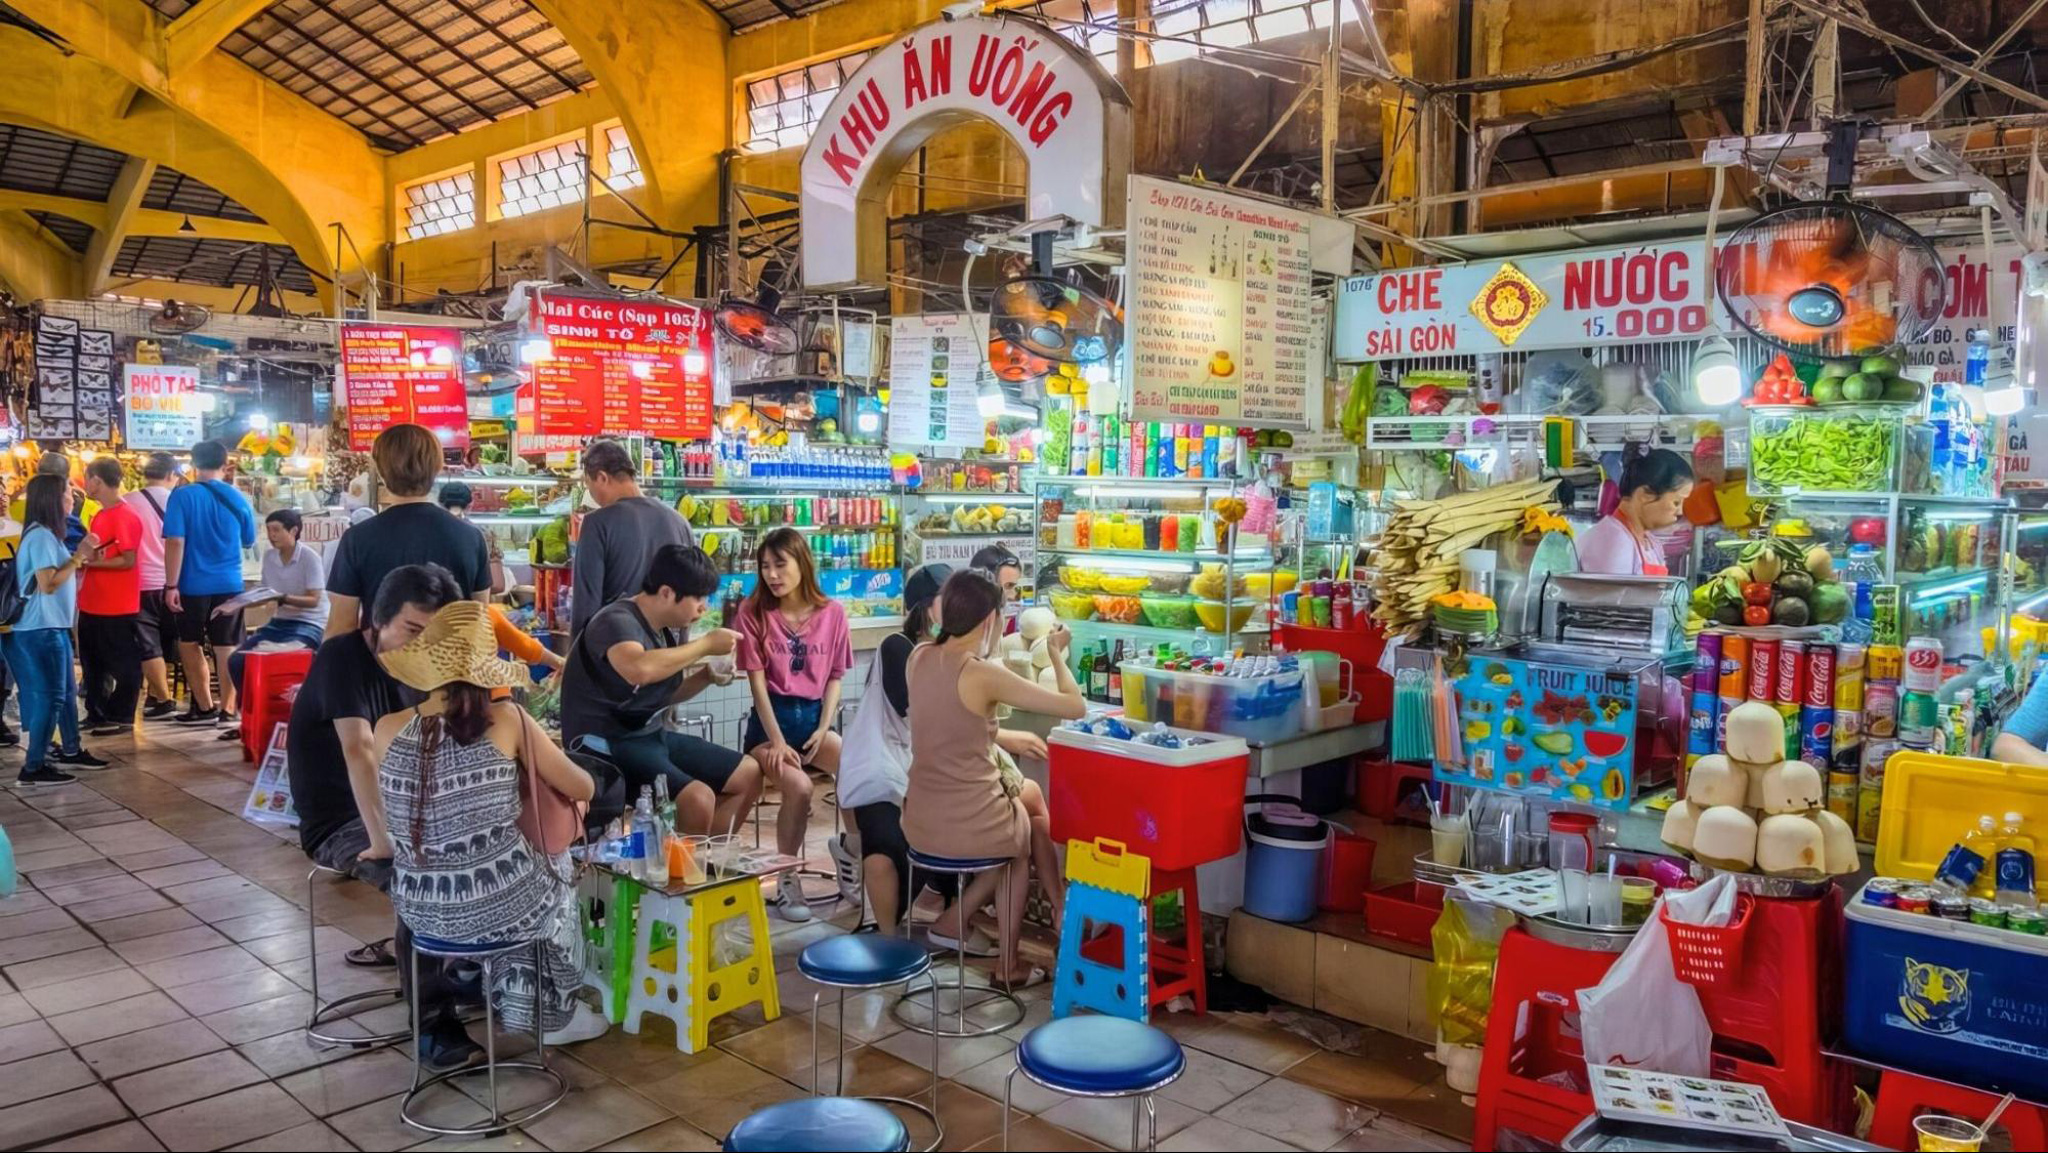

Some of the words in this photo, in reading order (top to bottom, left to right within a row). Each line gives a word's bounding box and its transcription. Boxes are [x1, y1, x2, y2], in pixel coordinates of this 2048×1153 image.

[822, 77, 890, 186] KHU
[902, 36, 952, 109] ĂN
[968, 34, 1073, 148] UỐNG
[1564, 250, 1690, 312] NƯỚC
[579, 304, 614, 321] Cúc
[547, 324, 599, 338] SINH
[1366, 321, 1402, 356] SÀI
[1410, 317, 1456, 353] GÒN
[1527, 668, 1576, 692] FRUIT
